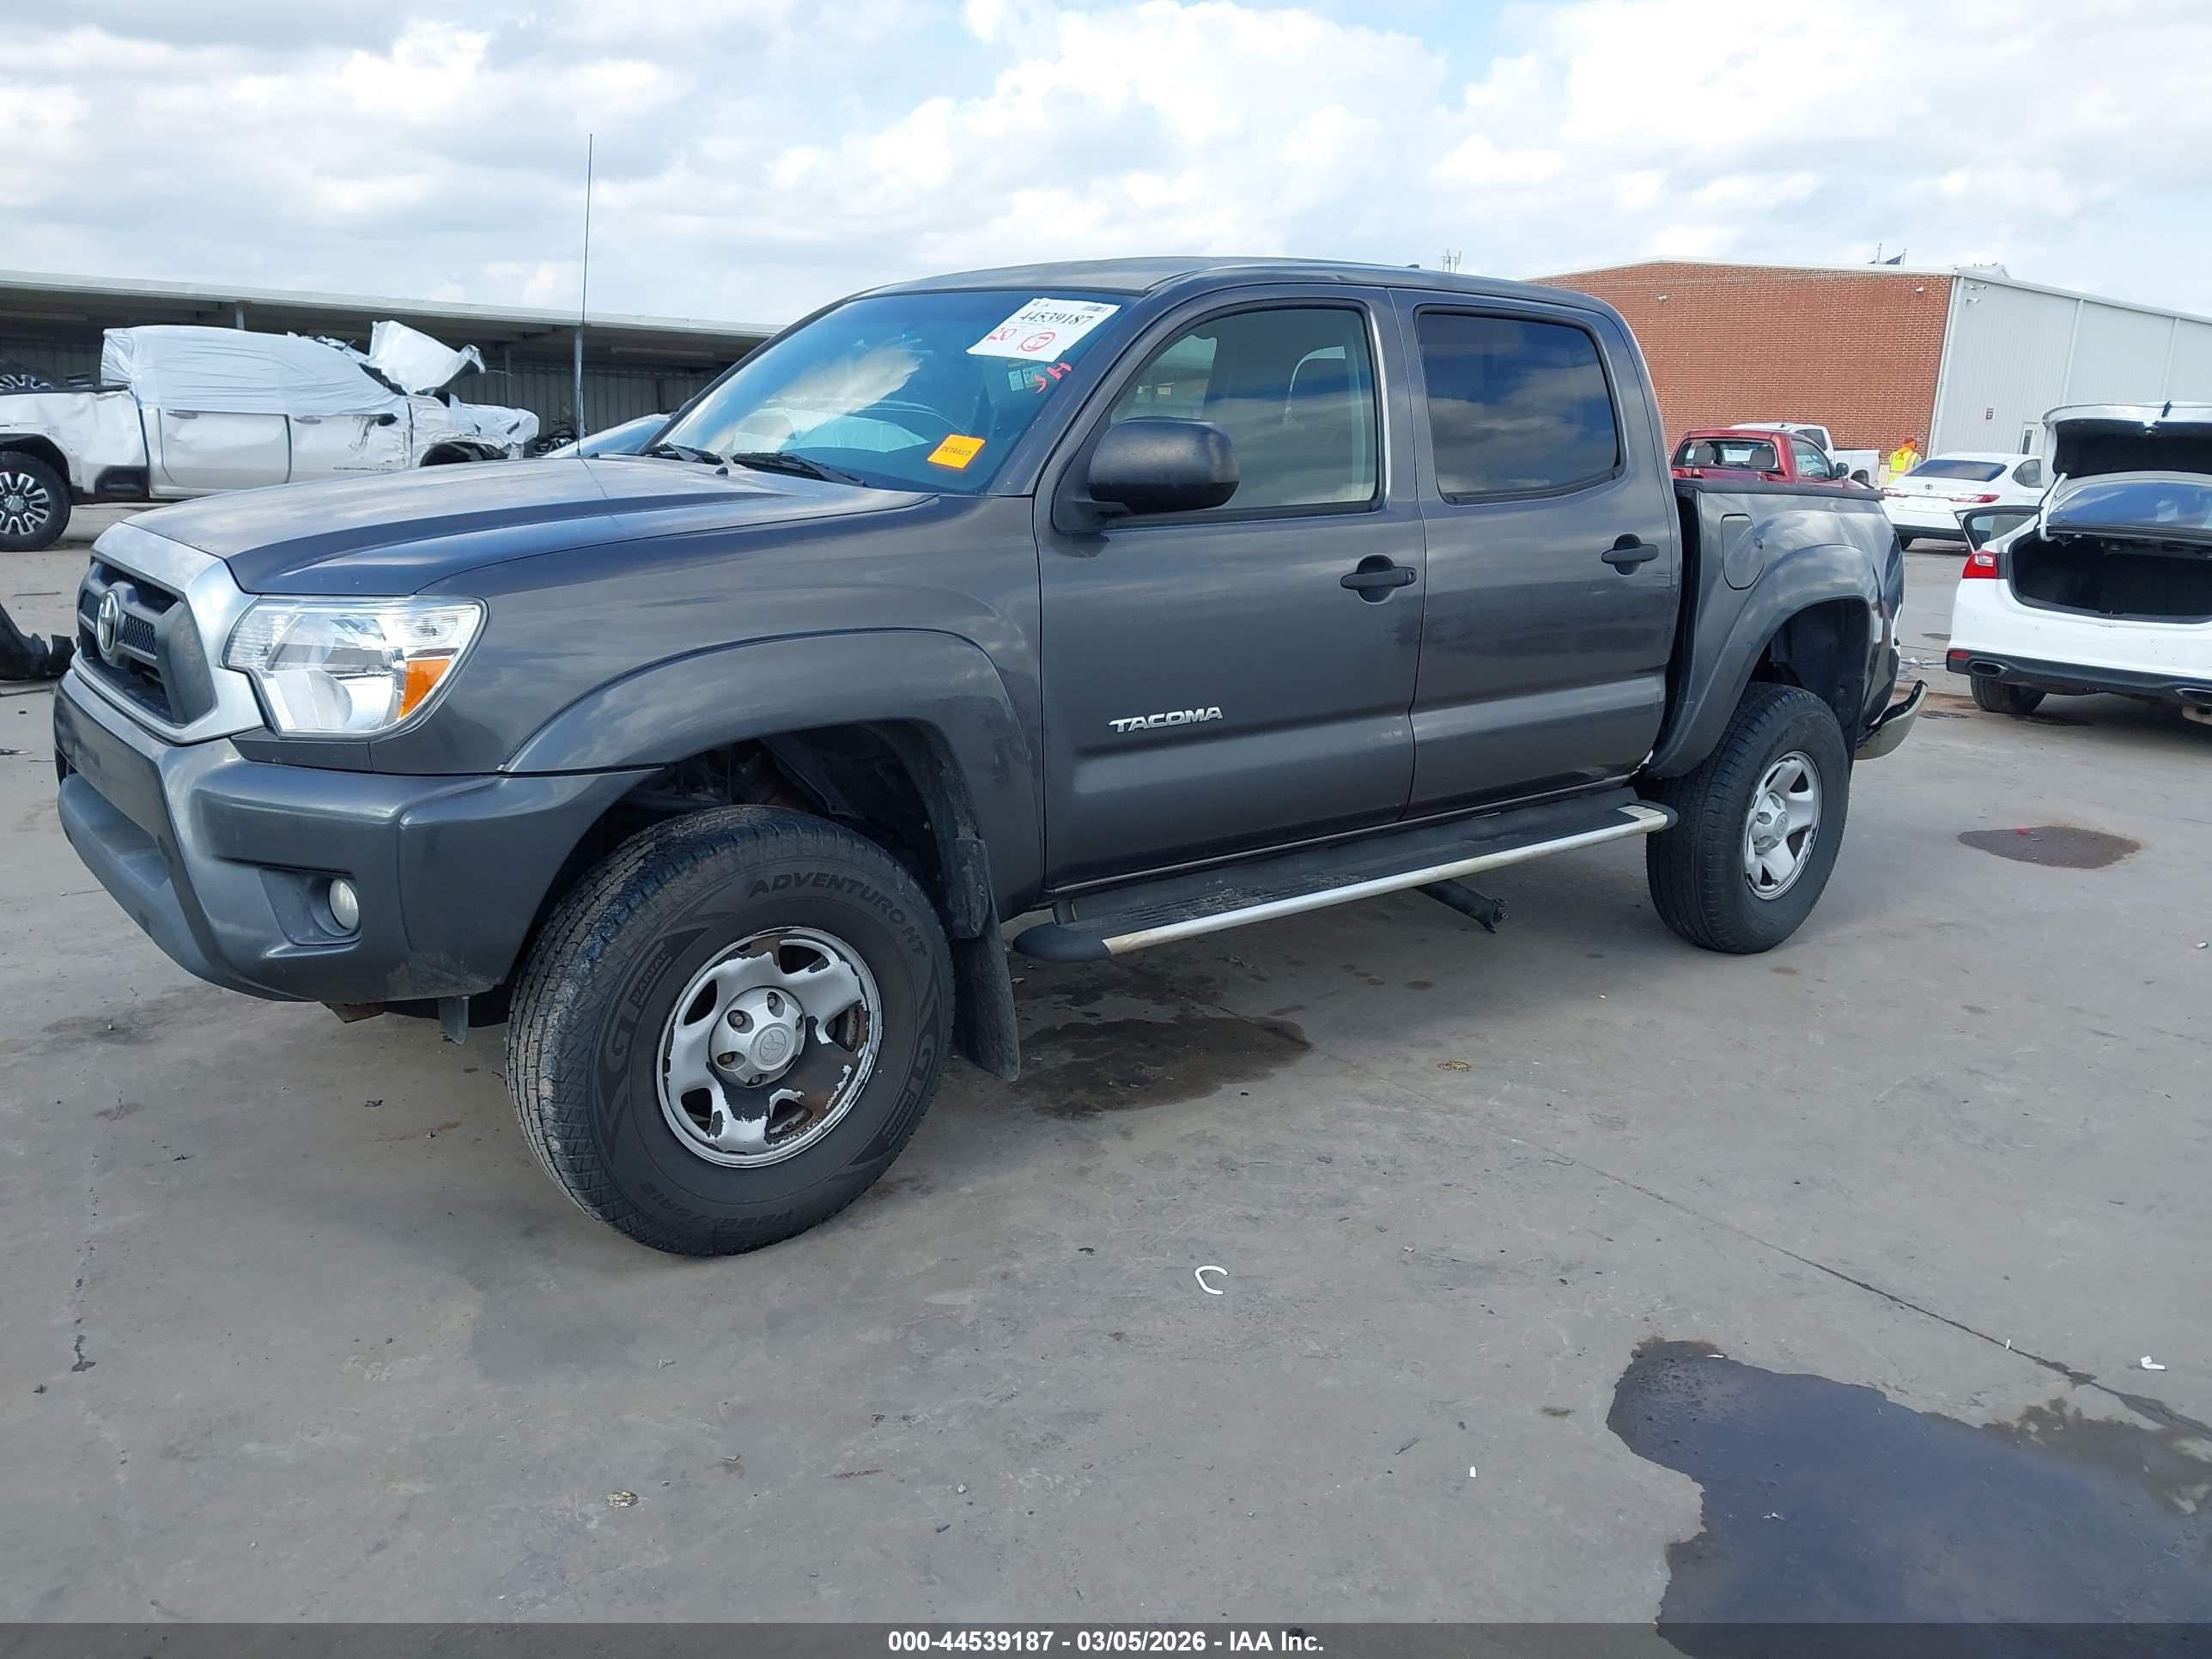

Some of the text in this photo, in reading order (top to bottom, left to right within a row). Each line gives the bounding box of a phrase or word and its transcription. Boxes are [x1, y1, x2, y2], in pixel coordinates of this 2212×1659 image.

[1020, 311, 1095, 326] 44539187
[1108, 706, 1224, 733] TACOMA
[748, 872, 905, 925] ADVENTURO
